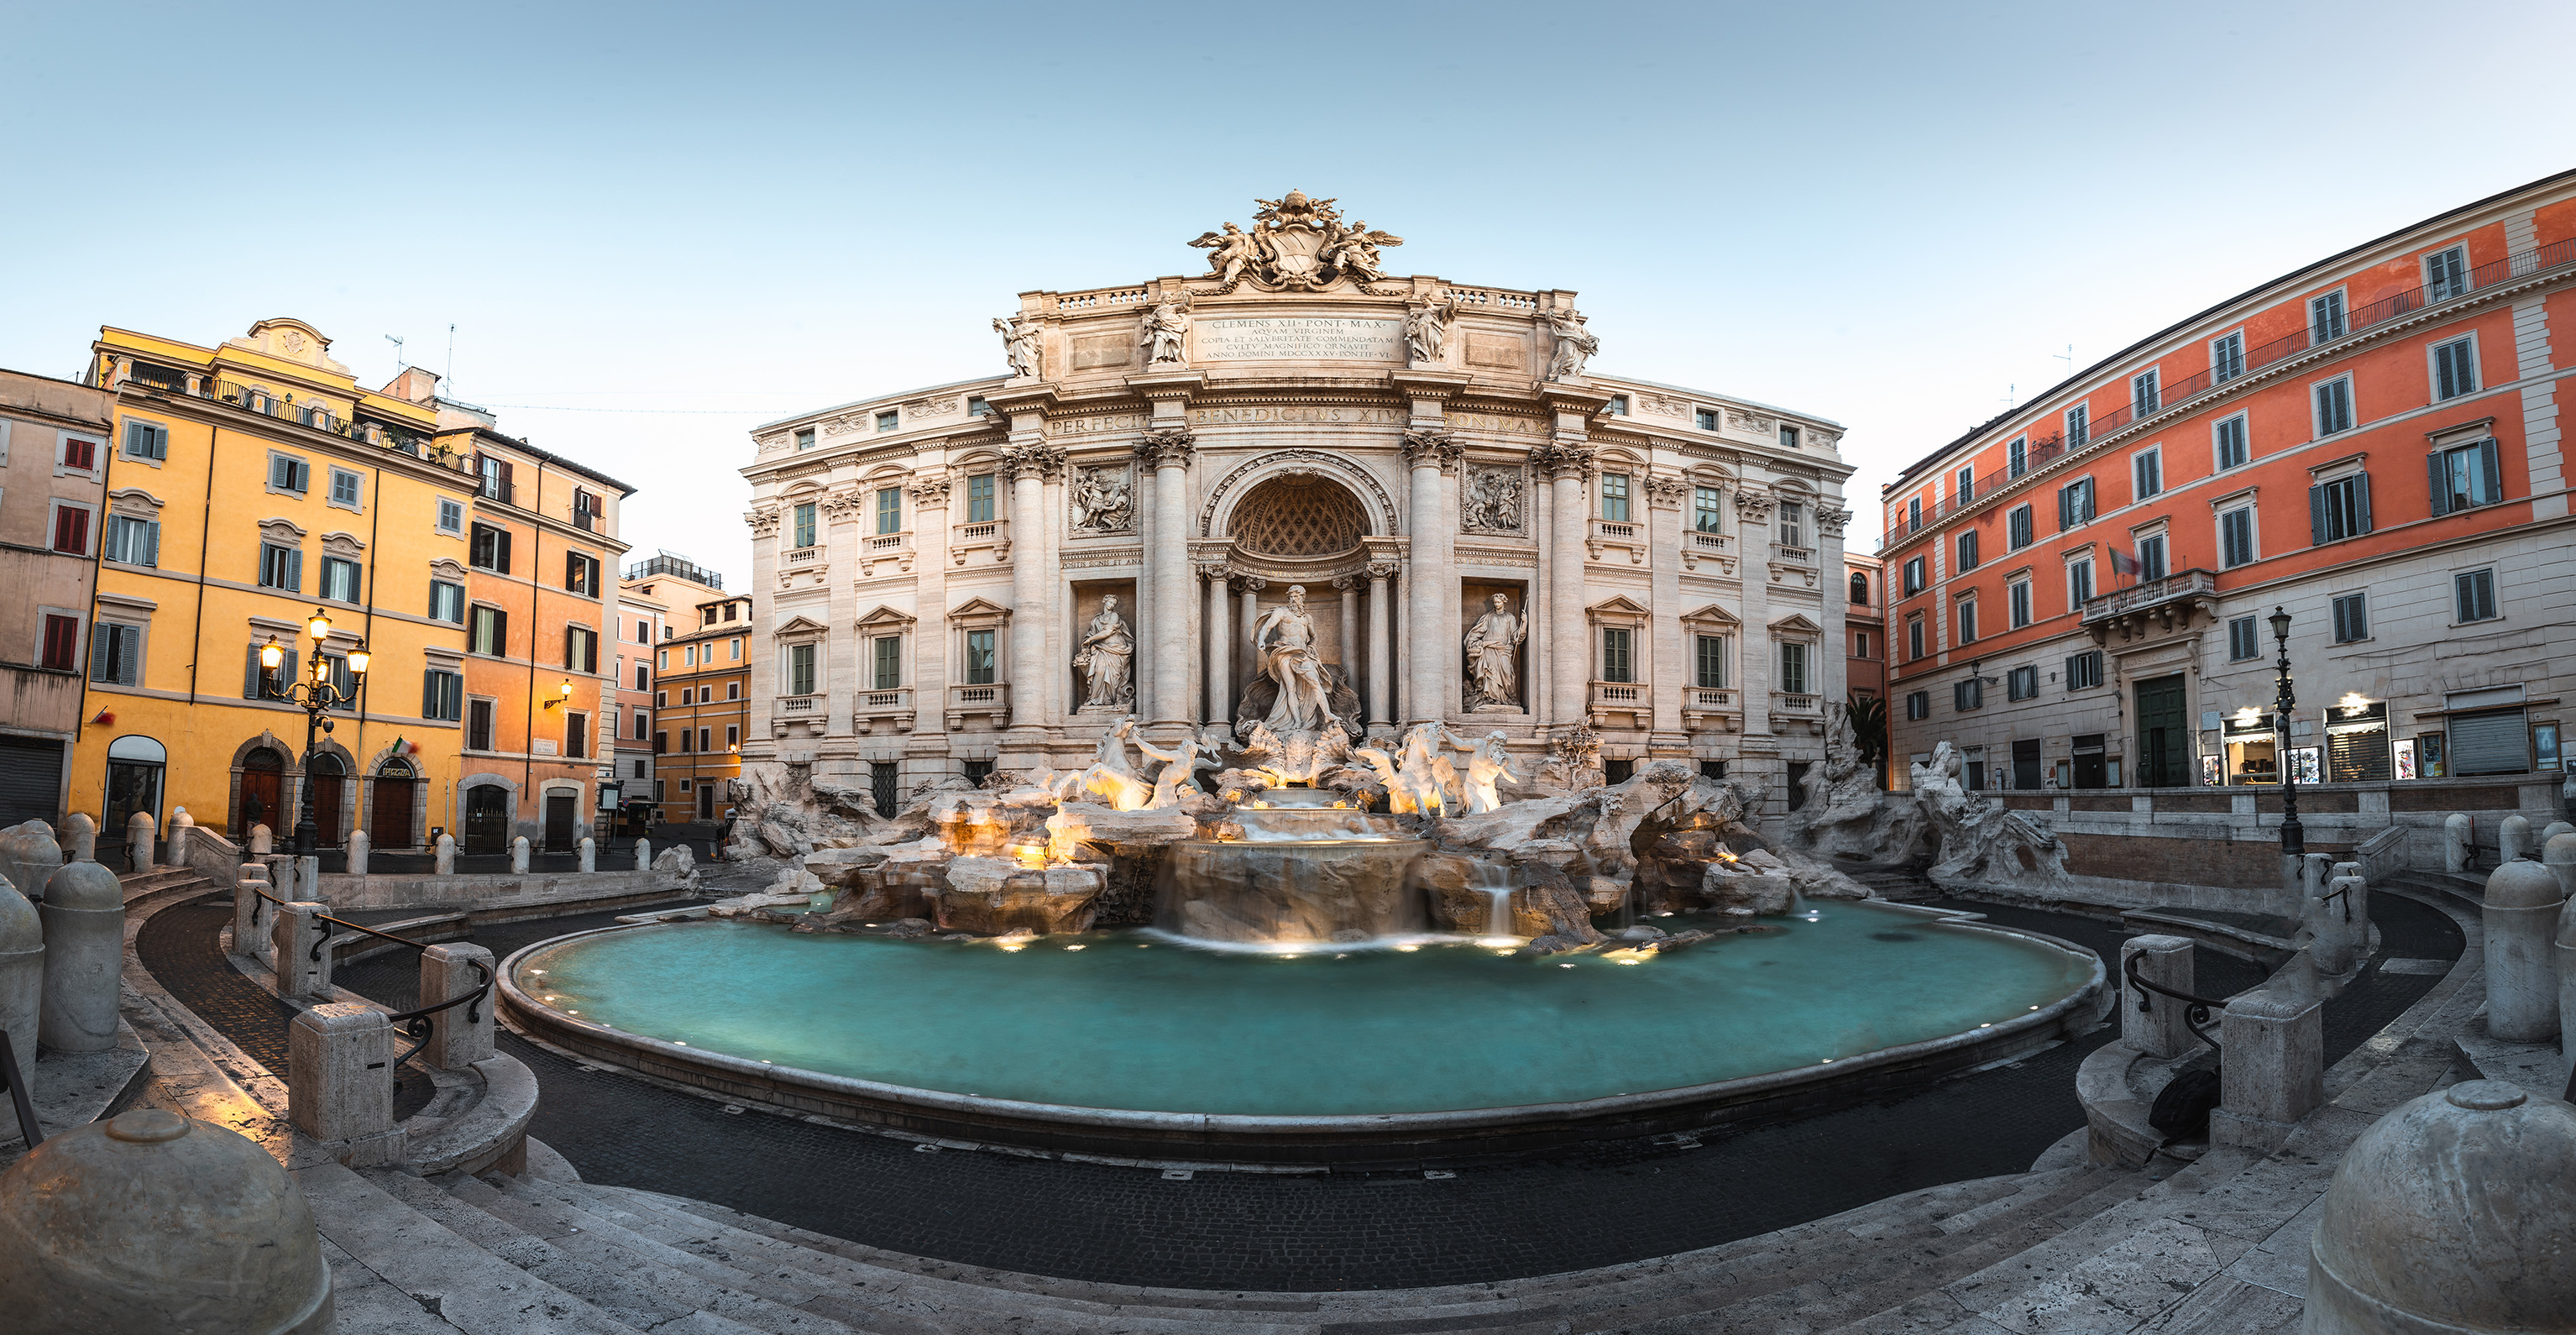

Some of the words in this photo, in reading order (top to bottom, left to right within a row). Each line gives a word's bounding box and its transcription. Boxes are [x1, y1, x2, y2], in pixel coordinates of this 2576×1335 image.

[1212, 319, 1271, 329] CLEMENS
[1316, 335, 1394, 343] COMMENDATAM
[1050, 413, 1151, 435] PERFECIT
[1196, 408, 1341, 423] BENEDICTVS
[383, 767, 411, 777] PIZZA
